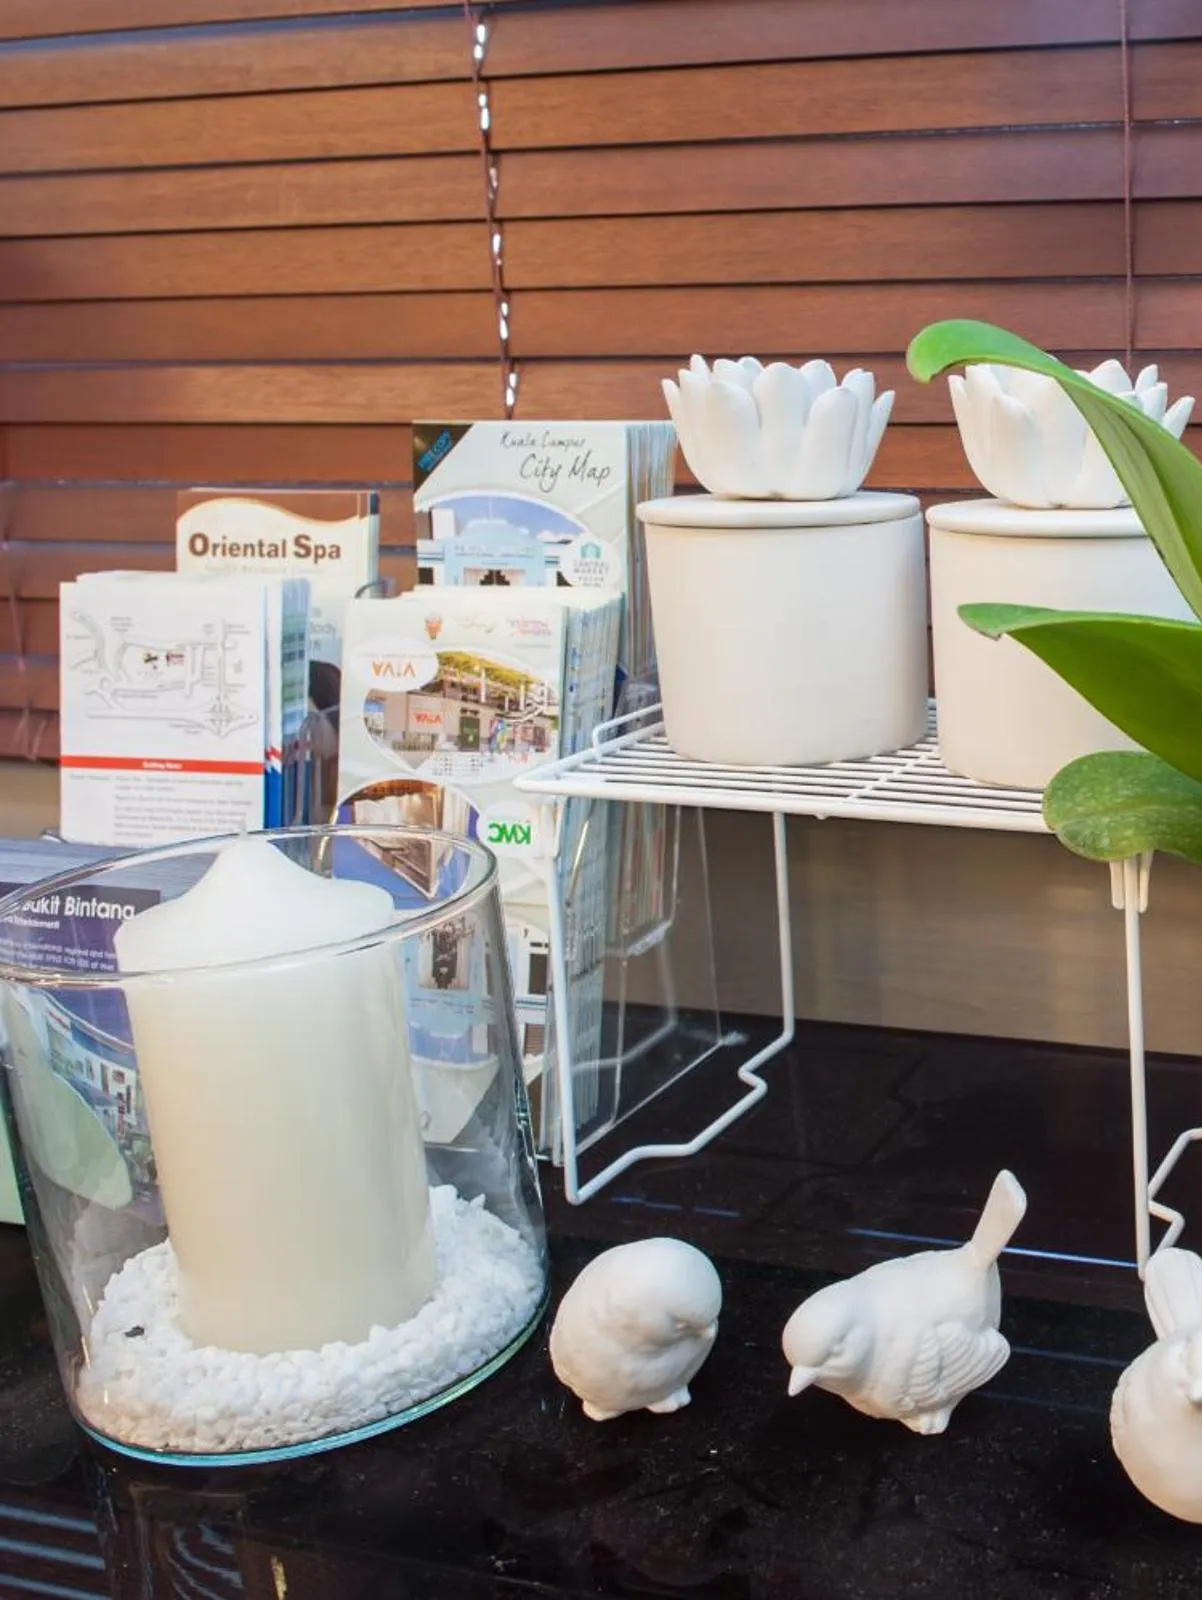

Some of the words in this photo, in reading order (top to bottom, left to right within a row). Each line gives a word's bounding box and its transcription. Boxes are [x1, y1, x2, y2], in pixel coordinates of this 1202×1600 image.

[500, 431, 537, 449] Kuala
[519, 451, 564, 493] City
[567, 449, 613, 487] Map
[188, 532, 288, 558] Oriental
[293, 533, 341, 564] Spa
[488, 822, 532, 845] KWC
